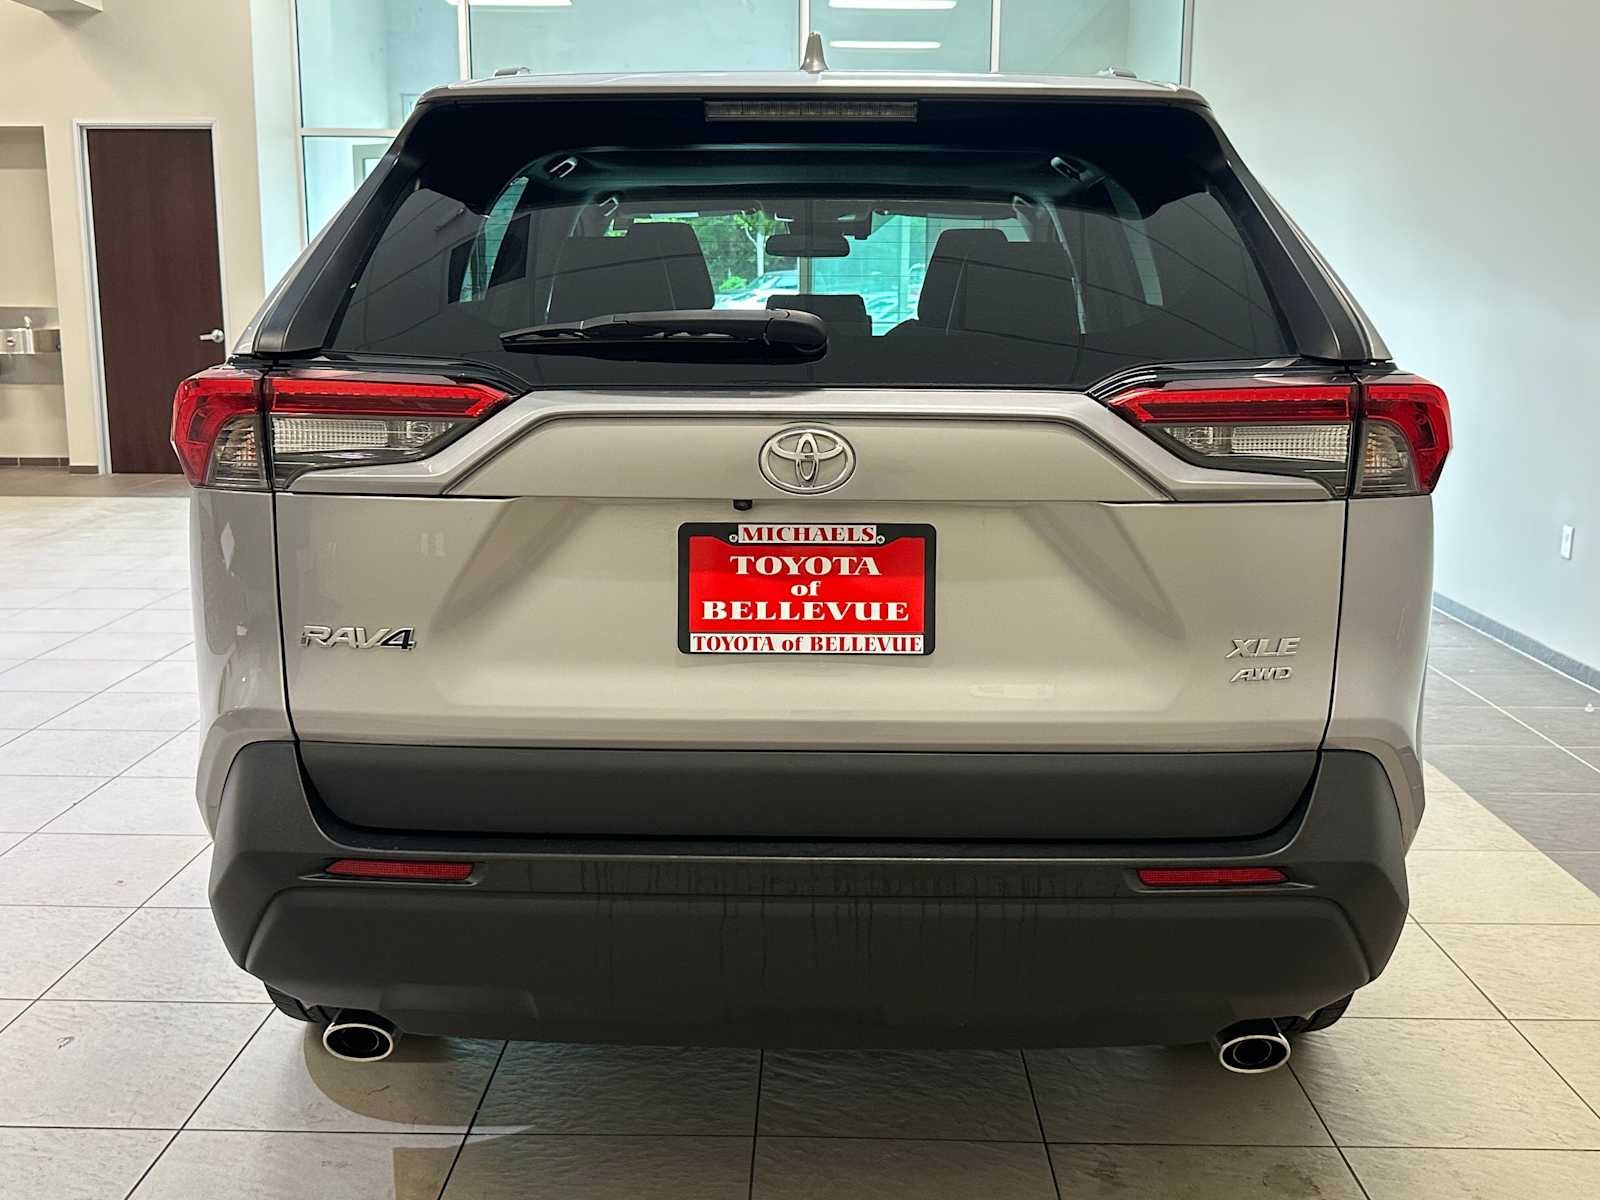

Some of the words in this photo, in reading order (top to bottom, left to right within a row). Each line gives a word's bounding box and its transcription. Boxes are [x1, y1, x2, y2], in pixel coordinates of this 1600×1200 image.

[742, 527, 874, 543] MICHAELS
[729, 556, 882, 576] TOYOTA
[790, 580, 822, 597] of
[701, 601, 909, 621] BELLEVUE
[301, 625, 416, 649] RAV4
[692, 635, 775, 651] TOYOTA
[781, 636, 802, 651] of
[810, 636, 922, 653] BELLEVUE
[1225, 637, 1301, 658] XLE
[1230, 666, 1292, 682] AWD
